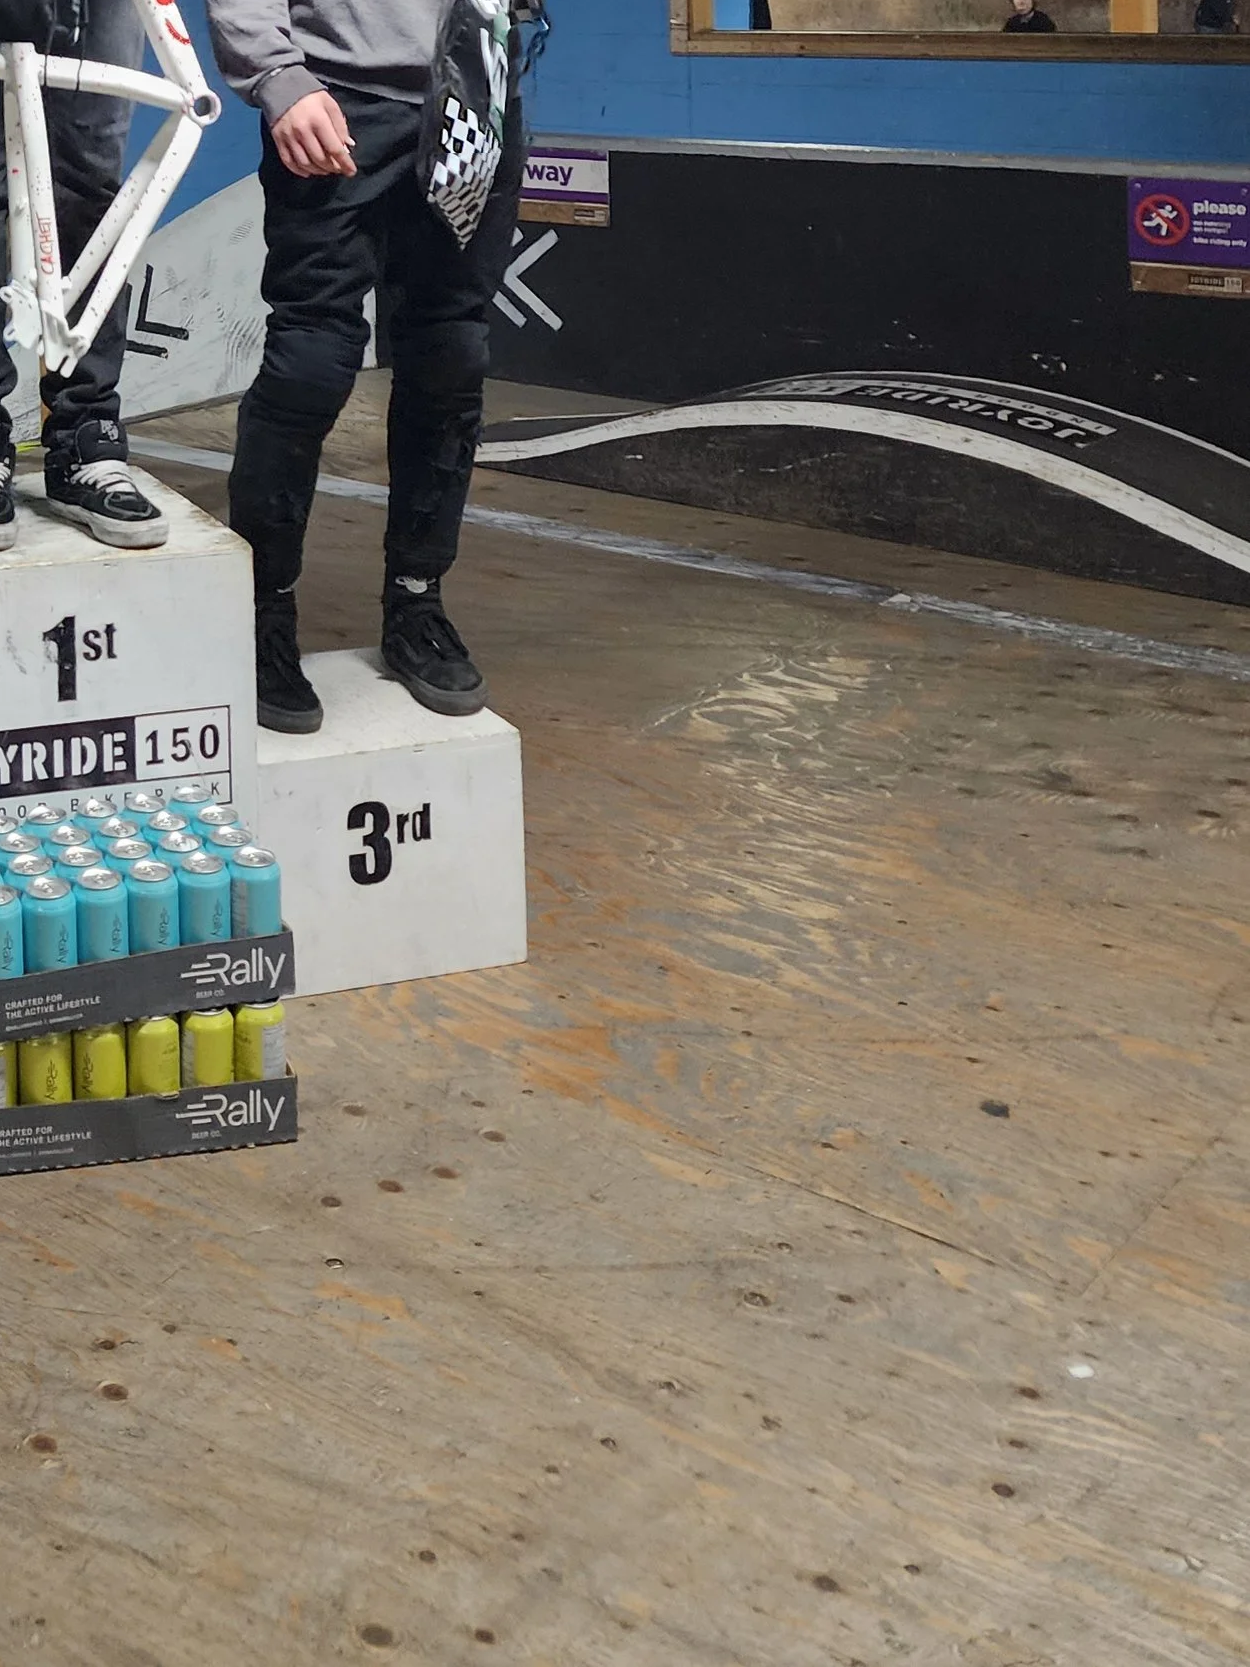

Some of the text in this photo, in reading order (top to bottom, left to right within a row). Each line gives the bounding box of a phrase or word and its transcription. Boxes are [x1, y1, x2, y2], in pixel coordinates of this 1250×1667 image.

[1192, 199, 1247, 216] please
[853, 385, 1091, 440] JOYRIDE
[41, 615, 118, 702] 1st
[144, 723, 221, 766] 150
[346, 800, 432, 886] 3rd
[181, 946, 287, 989] Rally
[4, 993, 63, 1011] CRAFTED FOR
[4, 996, 101, 1020] THE ACTIVE LIFESTYLE
[35, 1126, 53, 1135] FOR
[175, 1088, 286, 1132] Rally
[13, 1136, 44, 1146] ACTIVE
[46, 1131, 92, 1144] LIFESTYLE
